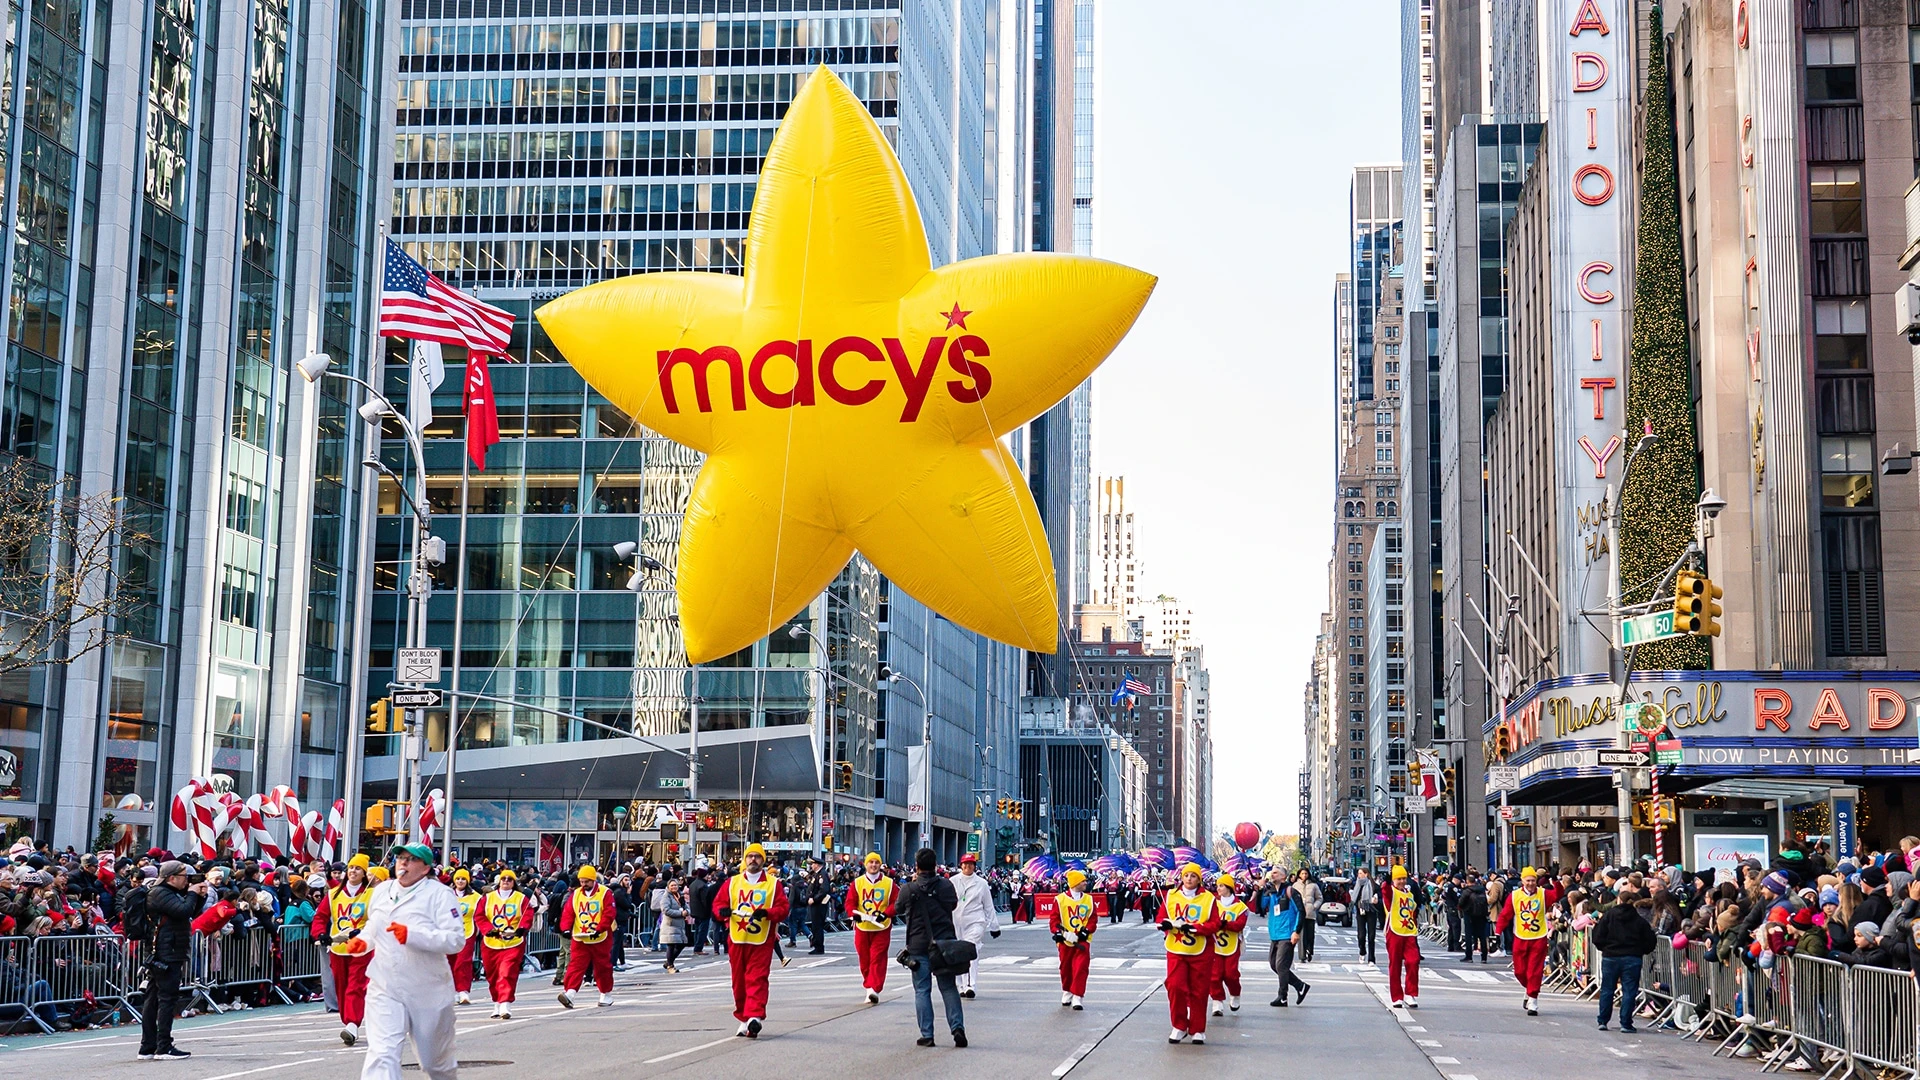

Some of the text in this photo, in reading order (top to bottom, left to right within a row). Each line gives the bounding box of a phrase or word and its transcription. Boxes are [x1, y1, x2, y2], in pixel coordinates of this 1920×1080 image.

[1576, 261, 1621, 478] CITY
[1577, 499, 1609, 537] MUS
[1585, 531, 1610, 567] HA
[1656, 616, 1670, 634] 50
[400, 695, 414, 703] ONE
[1699, 748, 1744, 764] NOW
[1759, 748, 1849, 764] PLAYING
[1572, 820, 1599, 829] Subway
[1839, 820, 1848, 854] Avenue
[1707, 846, 1756, 861] Carter
